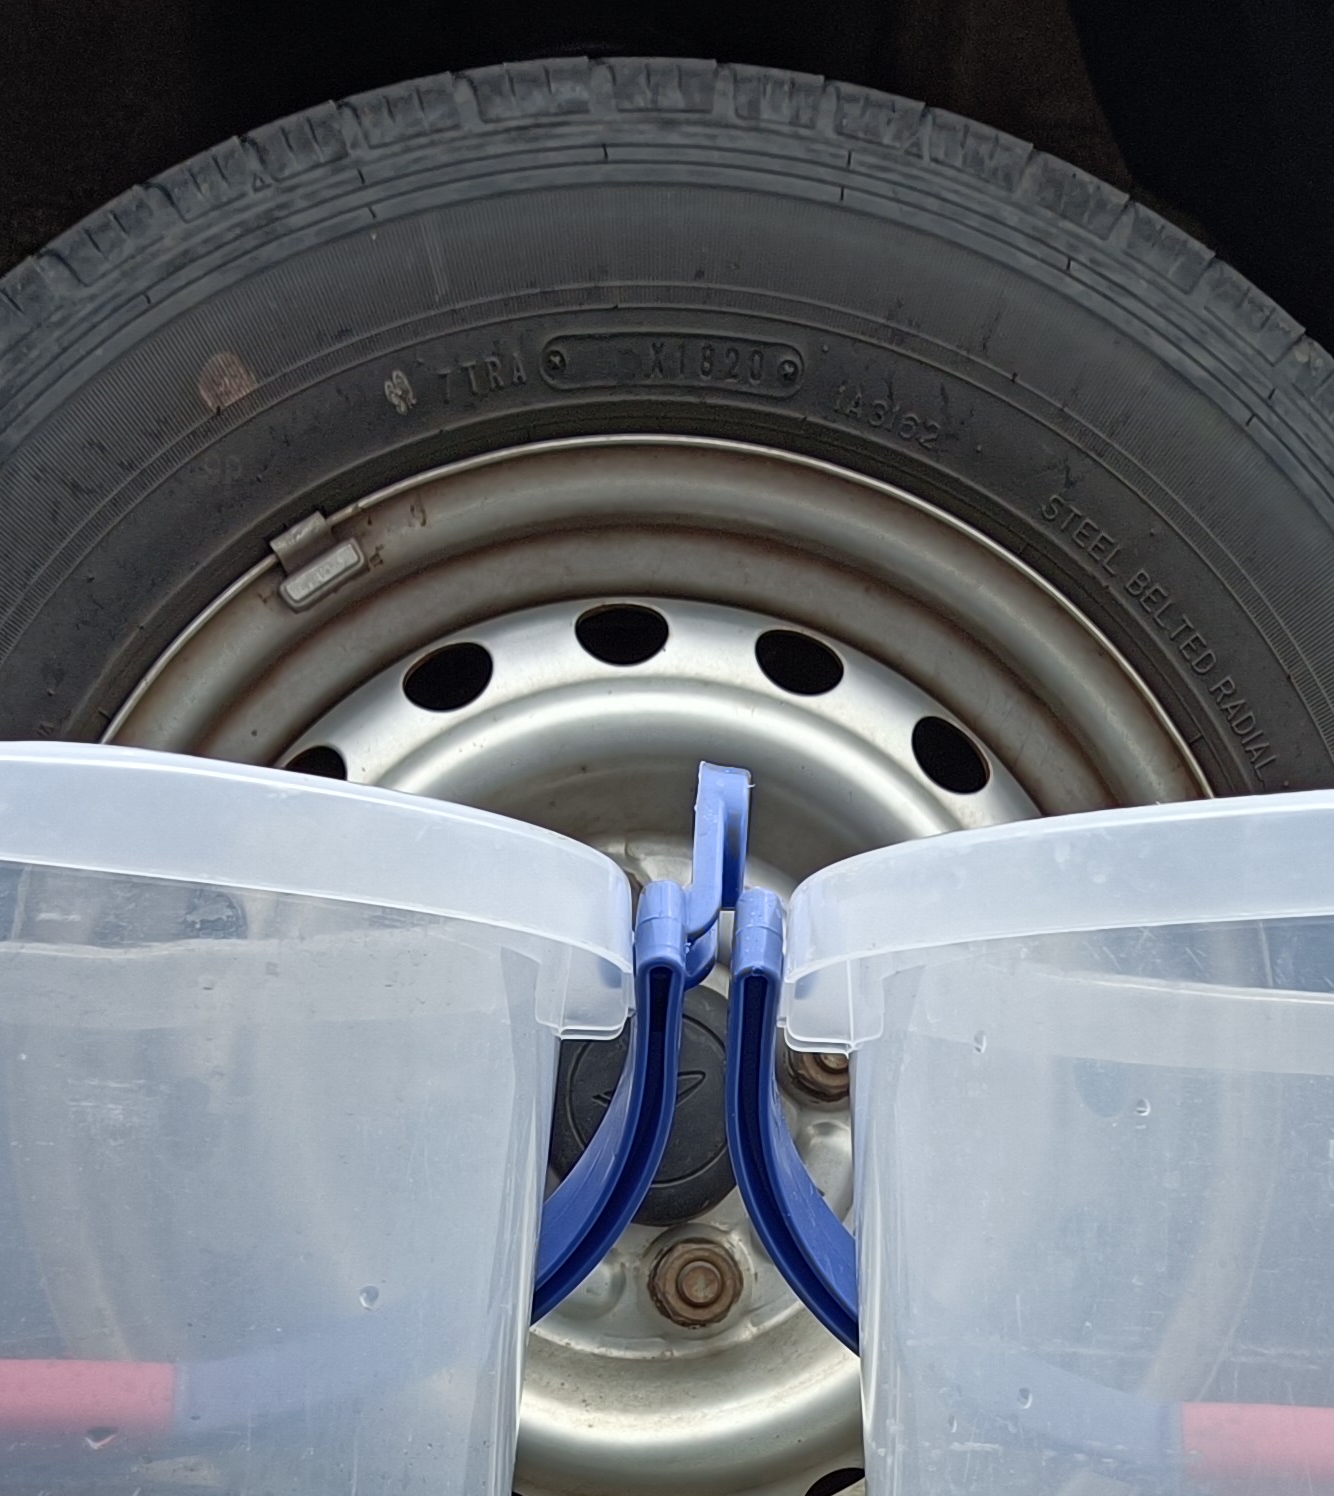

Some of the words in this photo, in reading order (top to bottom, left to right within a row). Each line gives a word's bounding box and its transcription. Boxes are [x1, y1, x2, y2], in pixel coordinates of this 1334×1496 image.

[1041, 494, 1121, 577] STEEL
[1123, 567, 1217, 675] BELTED
[1209, 674, 1278, 782] RADIAL
